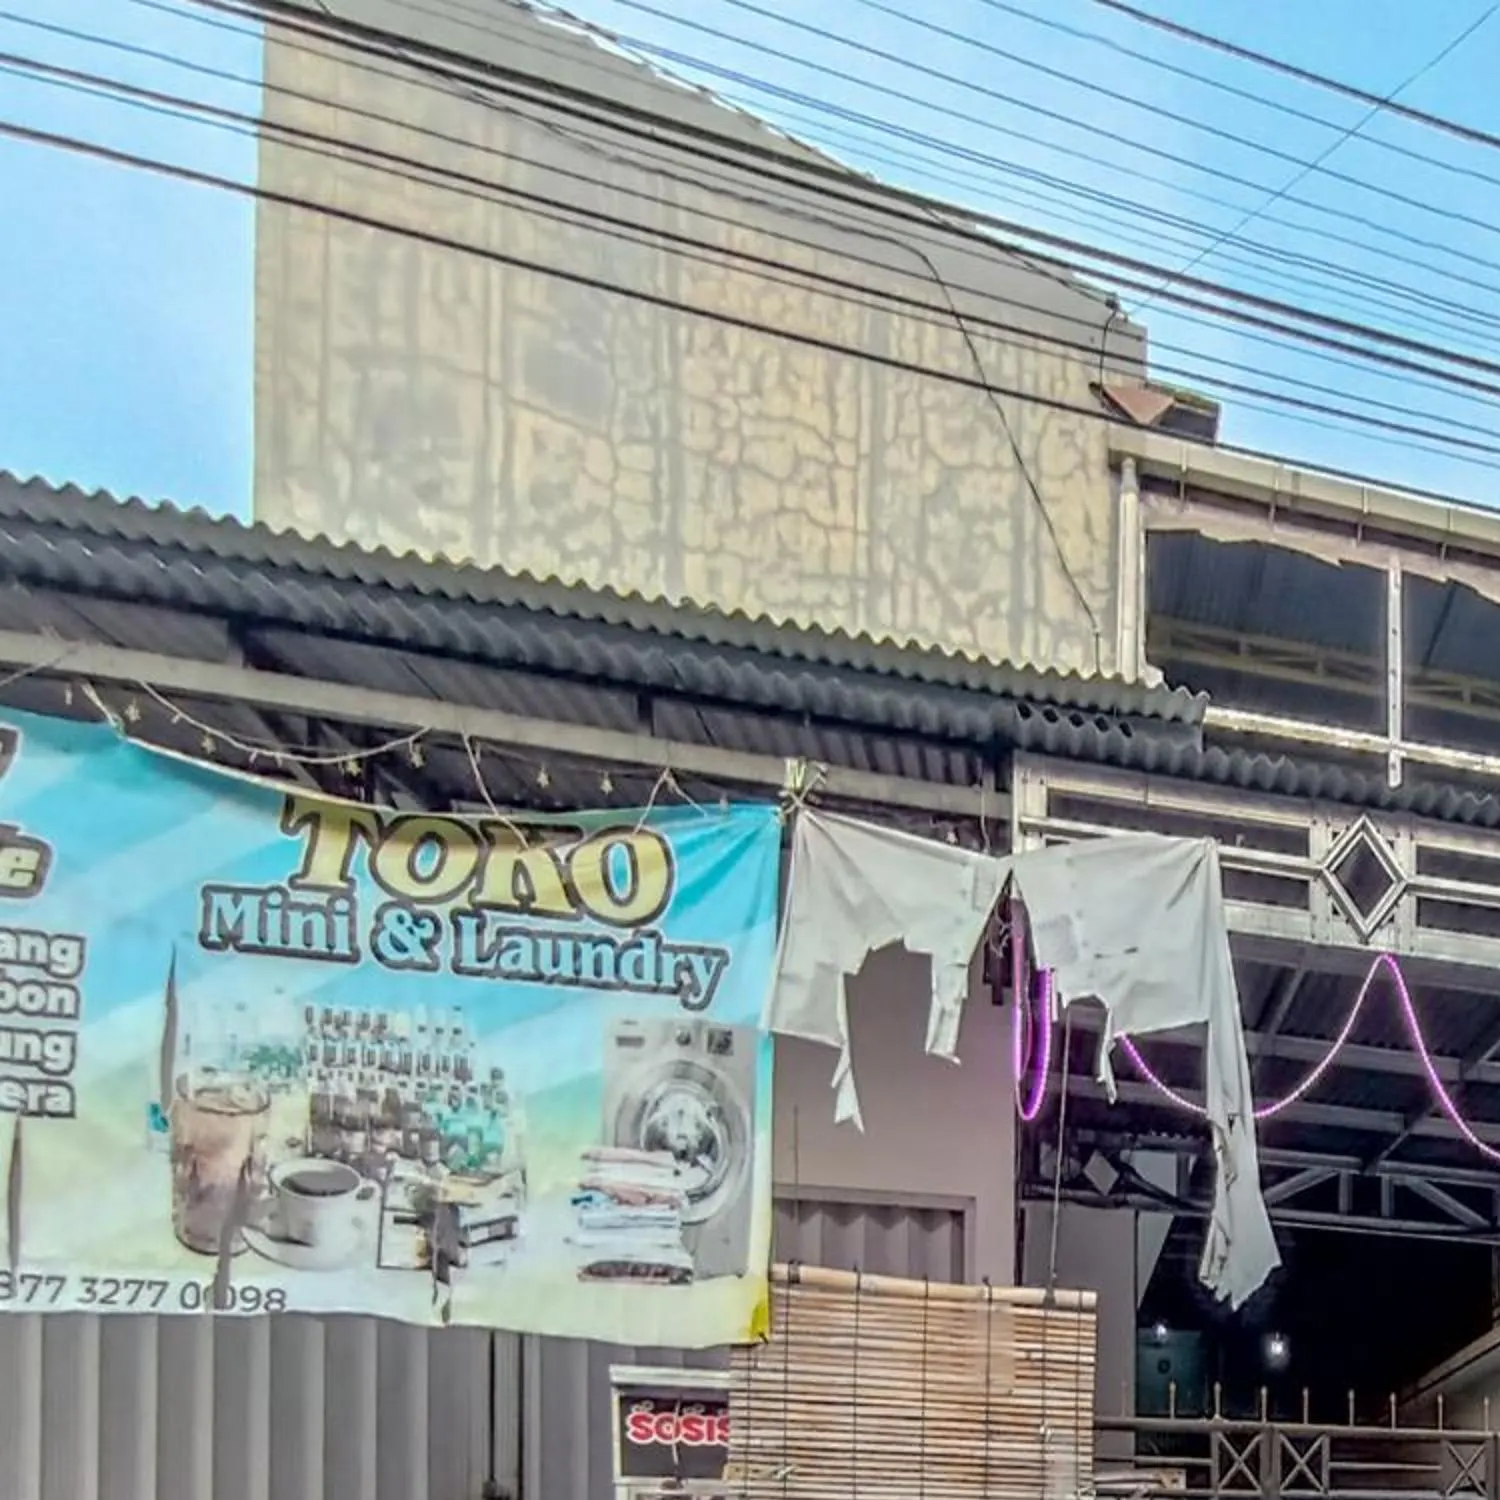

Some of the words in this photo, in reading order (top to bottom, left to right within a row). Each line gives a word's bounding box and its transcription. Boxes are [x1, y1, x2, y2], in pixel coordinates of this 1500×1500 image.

[202, 886, 361, 964] Mini
[370, 900, 440, 971] &
[450, 906, 728, 1011] Laundry
[77, 1276, 168, 1308] 3277
